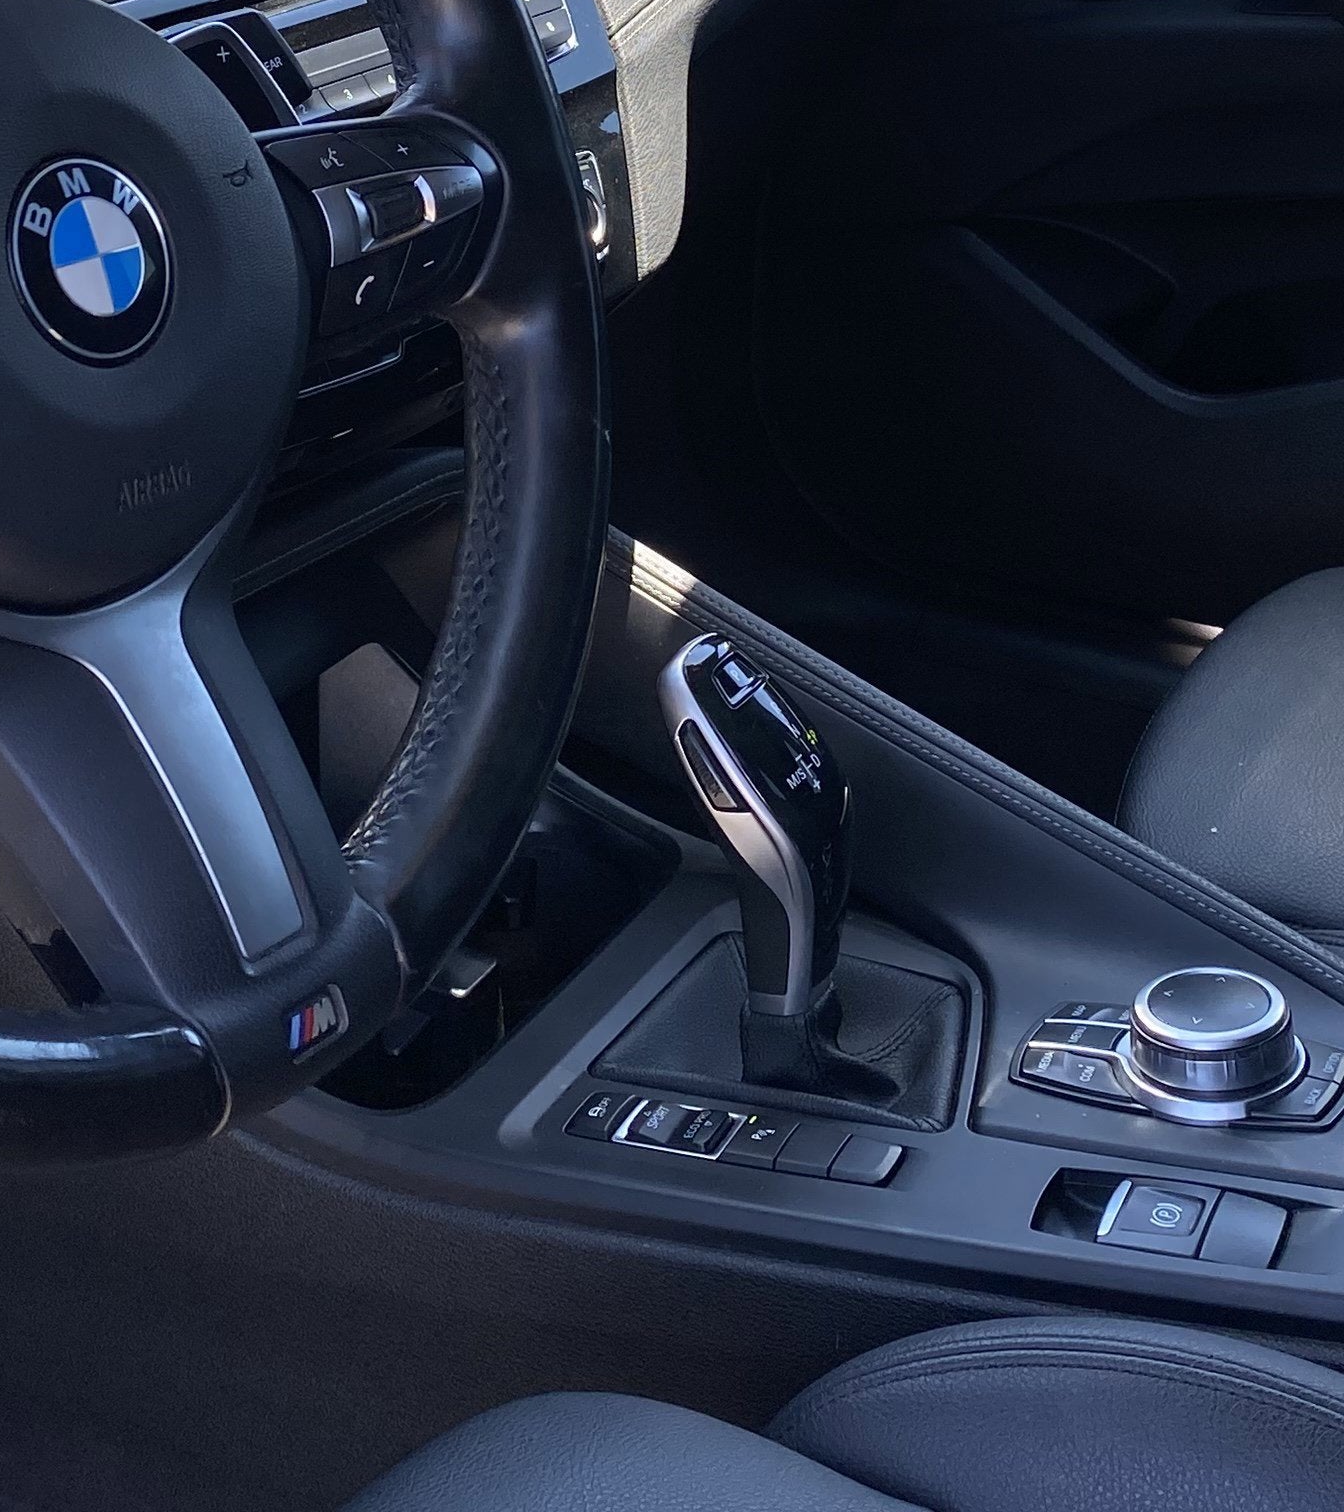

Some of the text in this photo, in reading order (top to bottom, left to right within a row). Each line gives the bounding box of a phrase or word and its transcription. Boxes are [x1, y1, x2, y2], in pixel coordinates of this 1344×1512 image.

[264, 56, 284, 73] EAR
[343, 88, 354, 101] 3
[22, 167, 141, 238] BMW
[118, 457, 192, 513] AIRBAG
[809, 753, 822, 768] D
[785, 767, 807, 790] M/S
[1036, 1050, 1055, 1073] MEDIA
[646, 1104, 670, 1130] SPORT
[683, 1122, 700, 1139] ECO
